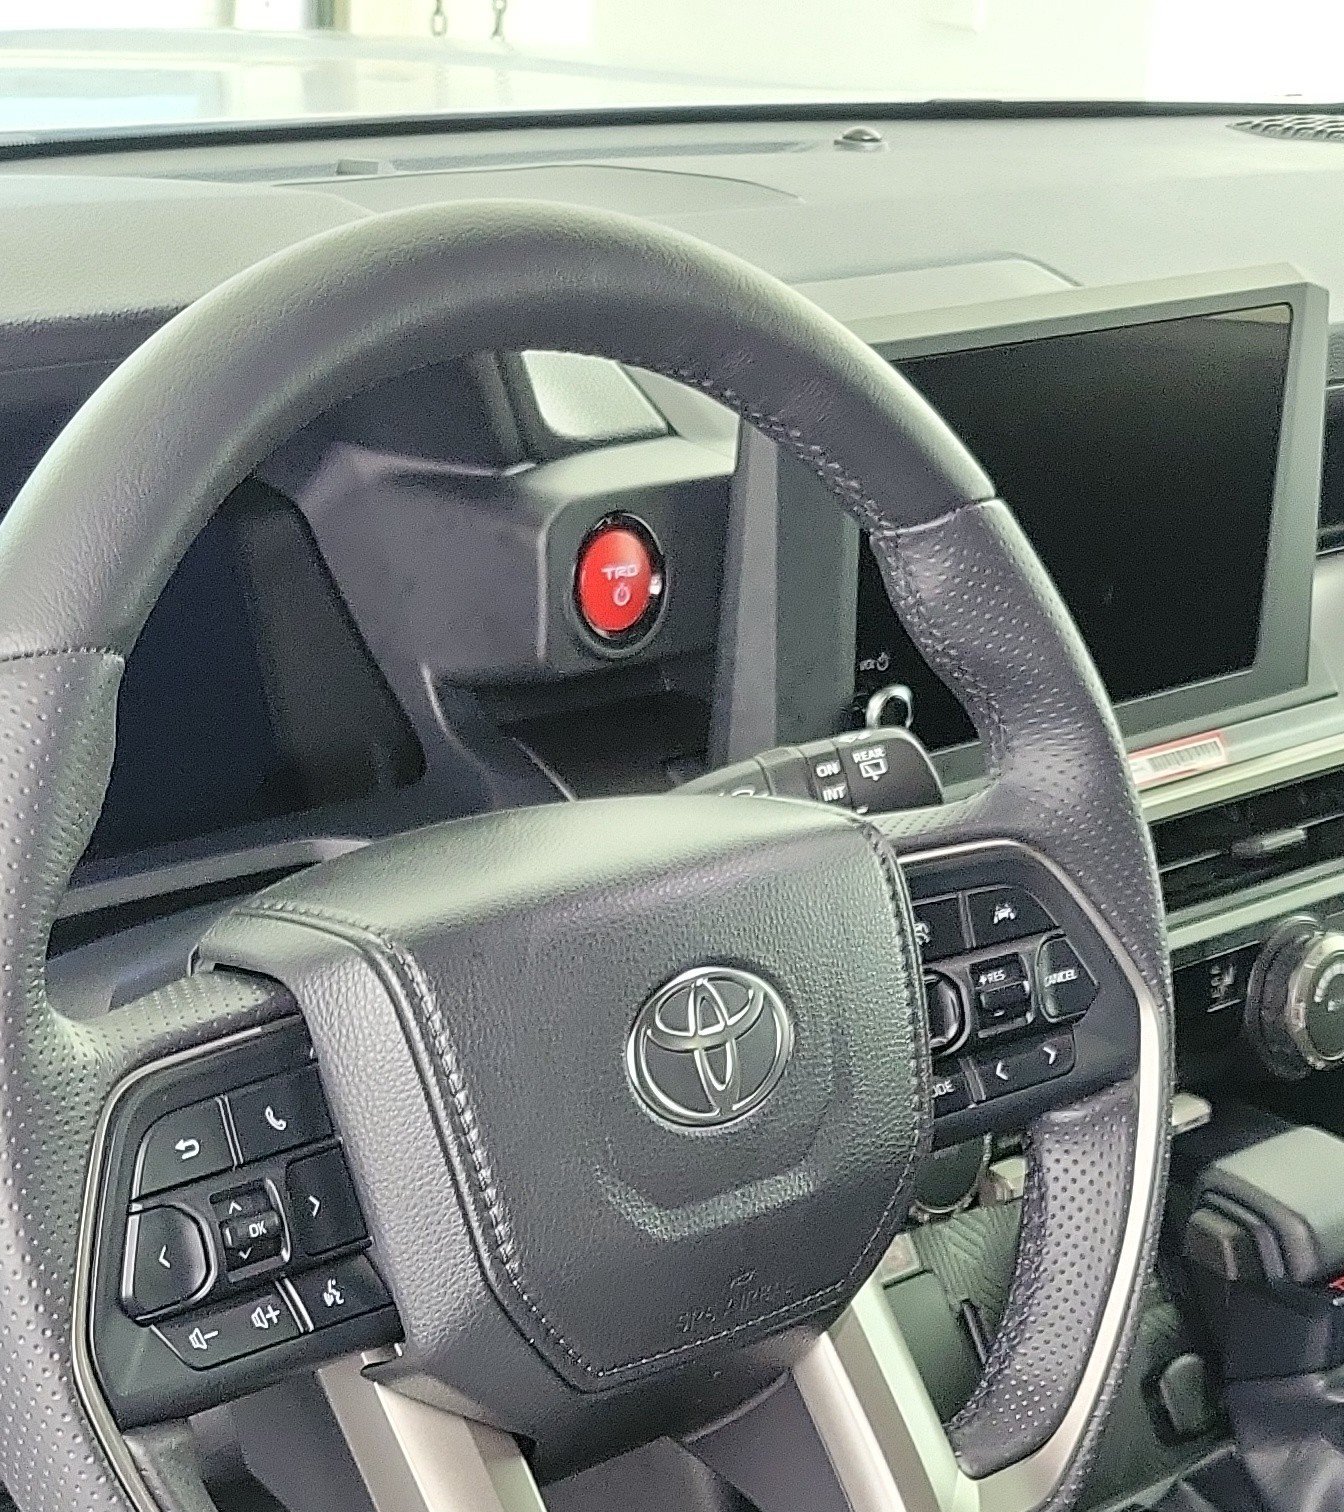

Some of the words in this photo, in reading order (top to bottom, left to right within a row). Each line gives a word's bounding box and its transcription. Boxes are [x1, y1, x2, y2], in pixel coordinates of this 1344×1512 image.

[602, 564, 638, 580] TRD
[852, 745, 885, 764] REAR
[816, 760, 840, 778] ON
[822, 782, 846, 802] INT
[248, 1220, 267, 1239] OK
